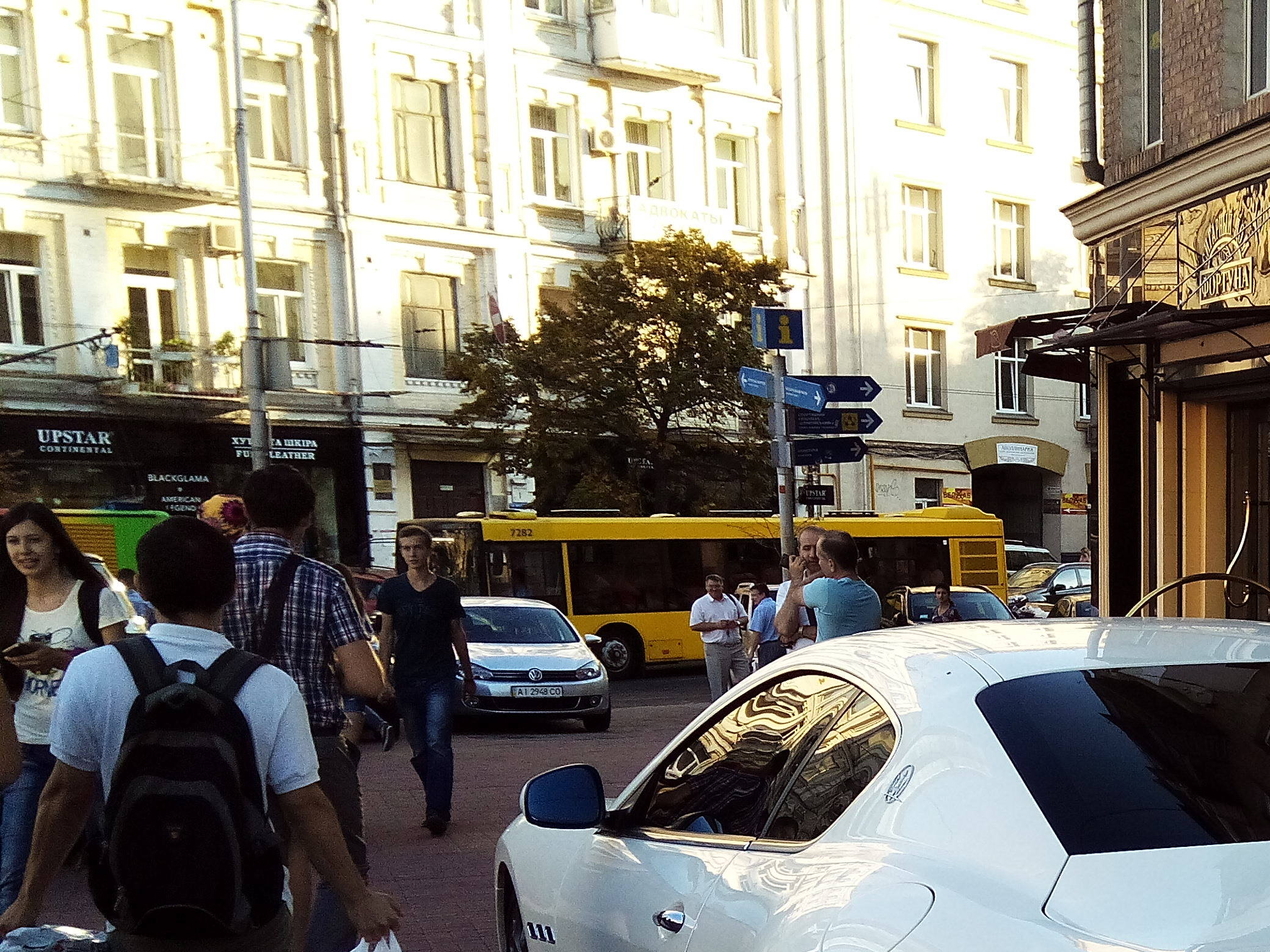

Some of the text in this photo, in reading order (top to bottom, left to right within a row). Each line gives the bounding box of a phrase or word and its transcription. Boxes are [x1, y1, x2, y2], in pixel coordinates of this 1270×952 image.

[639, 203, 723, 225] АДВОКАТЫ
[1201, 265, 1249, 299] ФОРТУНА
[36, 429, 112, 445] UPSTAR
[284, 439, 318, 448] ШКІРА
[39, 445, 113, 454] CONTINENTAL
[268, 451, 315, 460] LEATHER
[147, 473, 210, 483] BLACKGLAMA
[161, 495, 202, 503] AMERICAN
[510, 528, 533, 537] 7282
[530, 687, 548, 696] 2948
[549, 687, 561, 696] CO
